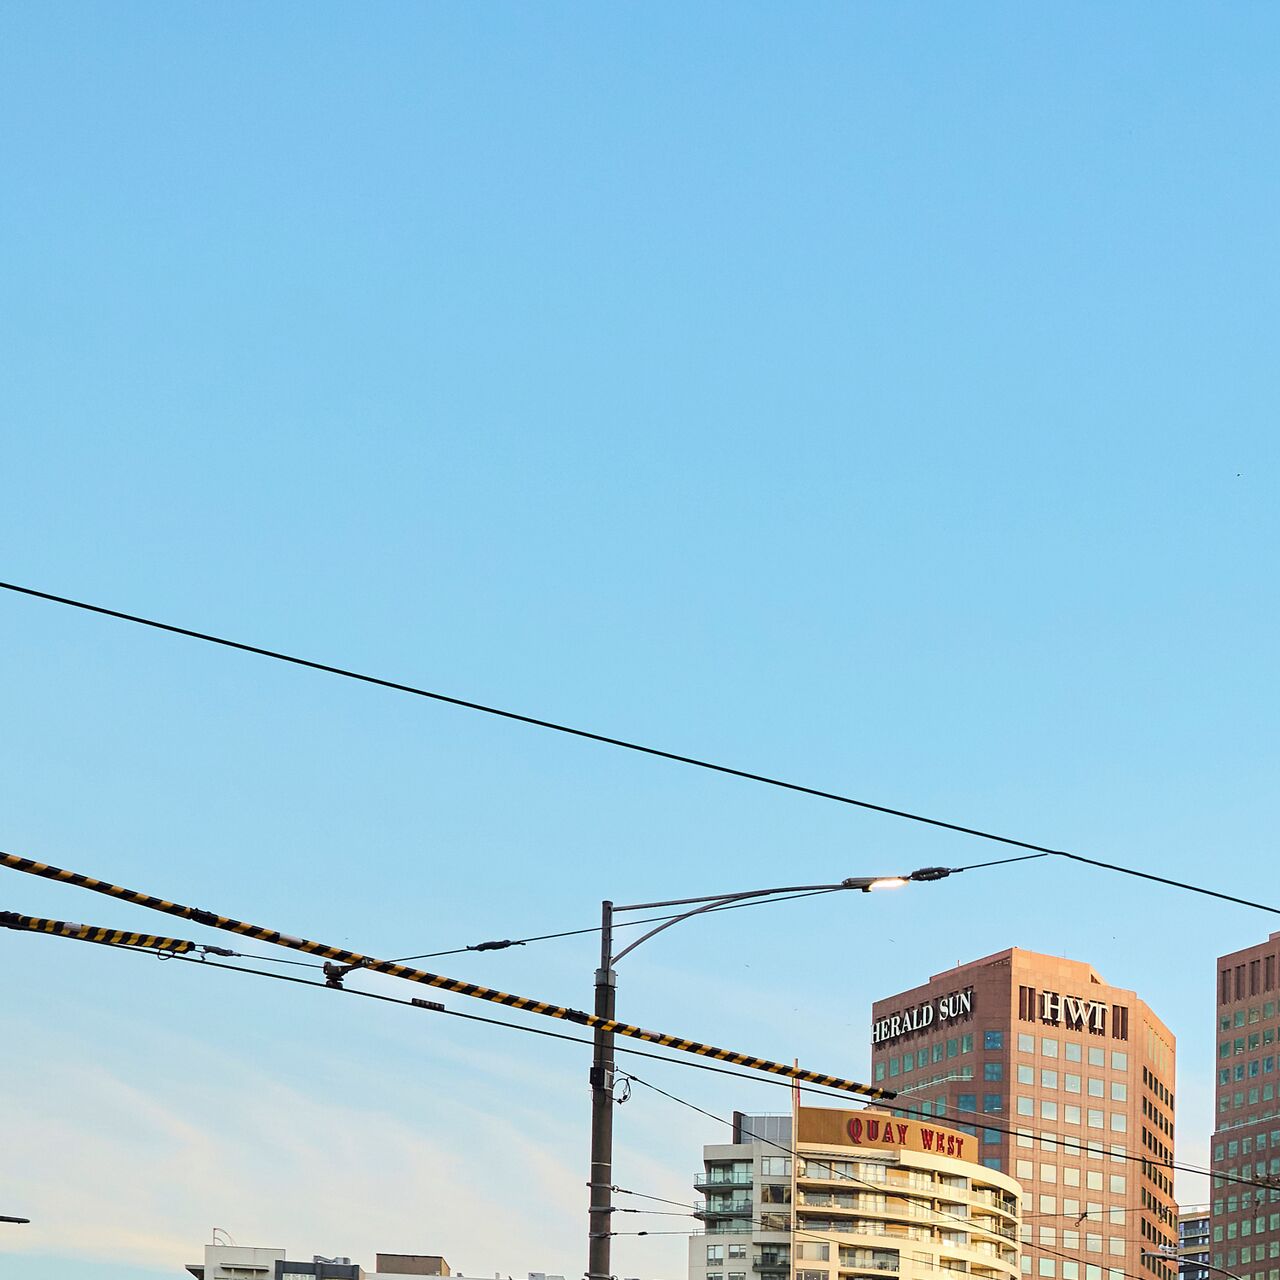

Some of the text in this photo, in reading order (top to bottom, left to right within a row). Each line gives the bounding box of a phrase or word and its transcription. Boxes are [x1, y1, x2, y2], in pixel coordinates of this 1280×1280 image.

[871, 990, 973, 1044] HERALD SUN
[1042, 992, 1109, 1030] HWT
[848, 1117, 964, 1159] QUAY WEST
